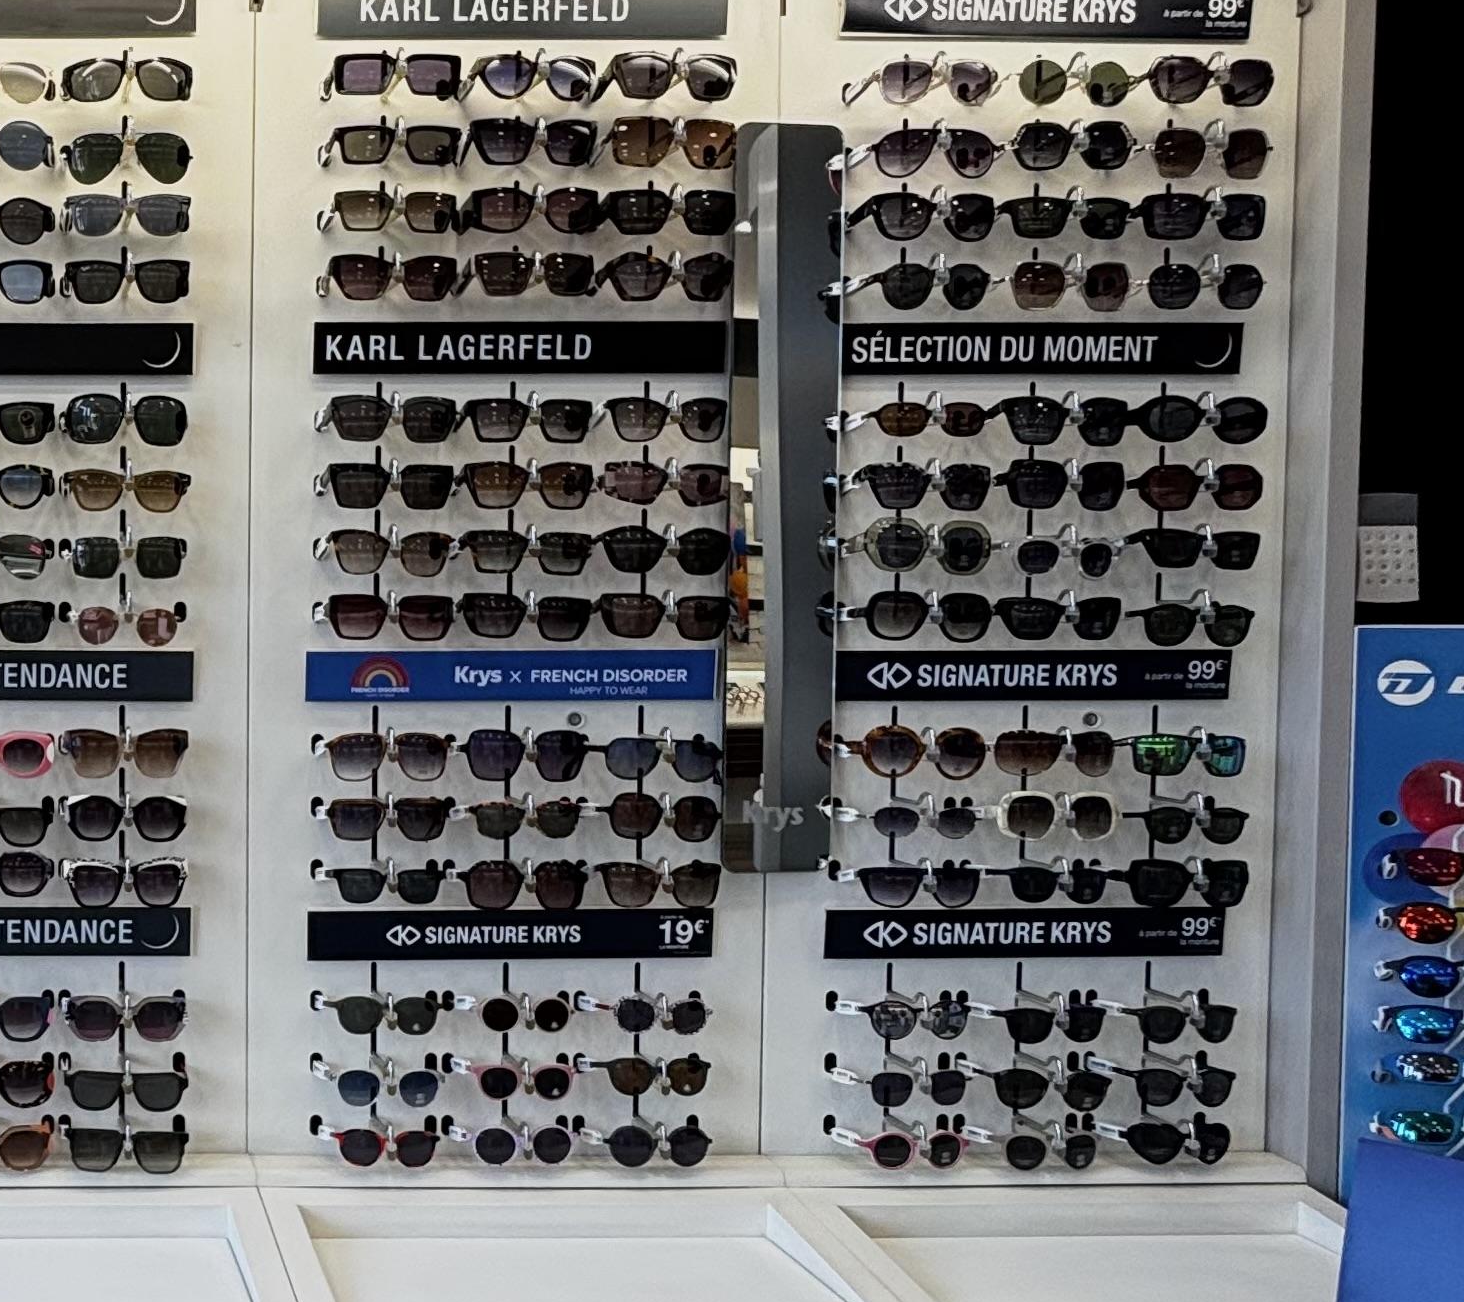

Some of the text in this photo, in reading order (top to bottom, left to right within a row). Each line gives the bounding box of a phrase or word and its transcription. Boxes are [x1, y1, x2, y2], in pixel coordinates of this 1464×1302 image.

[326, 334, 591, 360] KARL LAGERFELD
[852, 330, 1158, 363] SÉLECTION DU MOMENT
[455, 666, 501, 686] Krys
[531, 670, 598, 682] FRENCH
[603, 669, 687, 682] DISORDER
[917, 664, 1117, 687] SIGNATURE KRYS
[570, 686, 648, 695] HAPPY TO WEAR
[743, 799, 804, 832] Krys
[425, 925, 581, 944] SIGNATURE KRYS
[913, 921, 1111, 945] SIGNATURE KRYS
